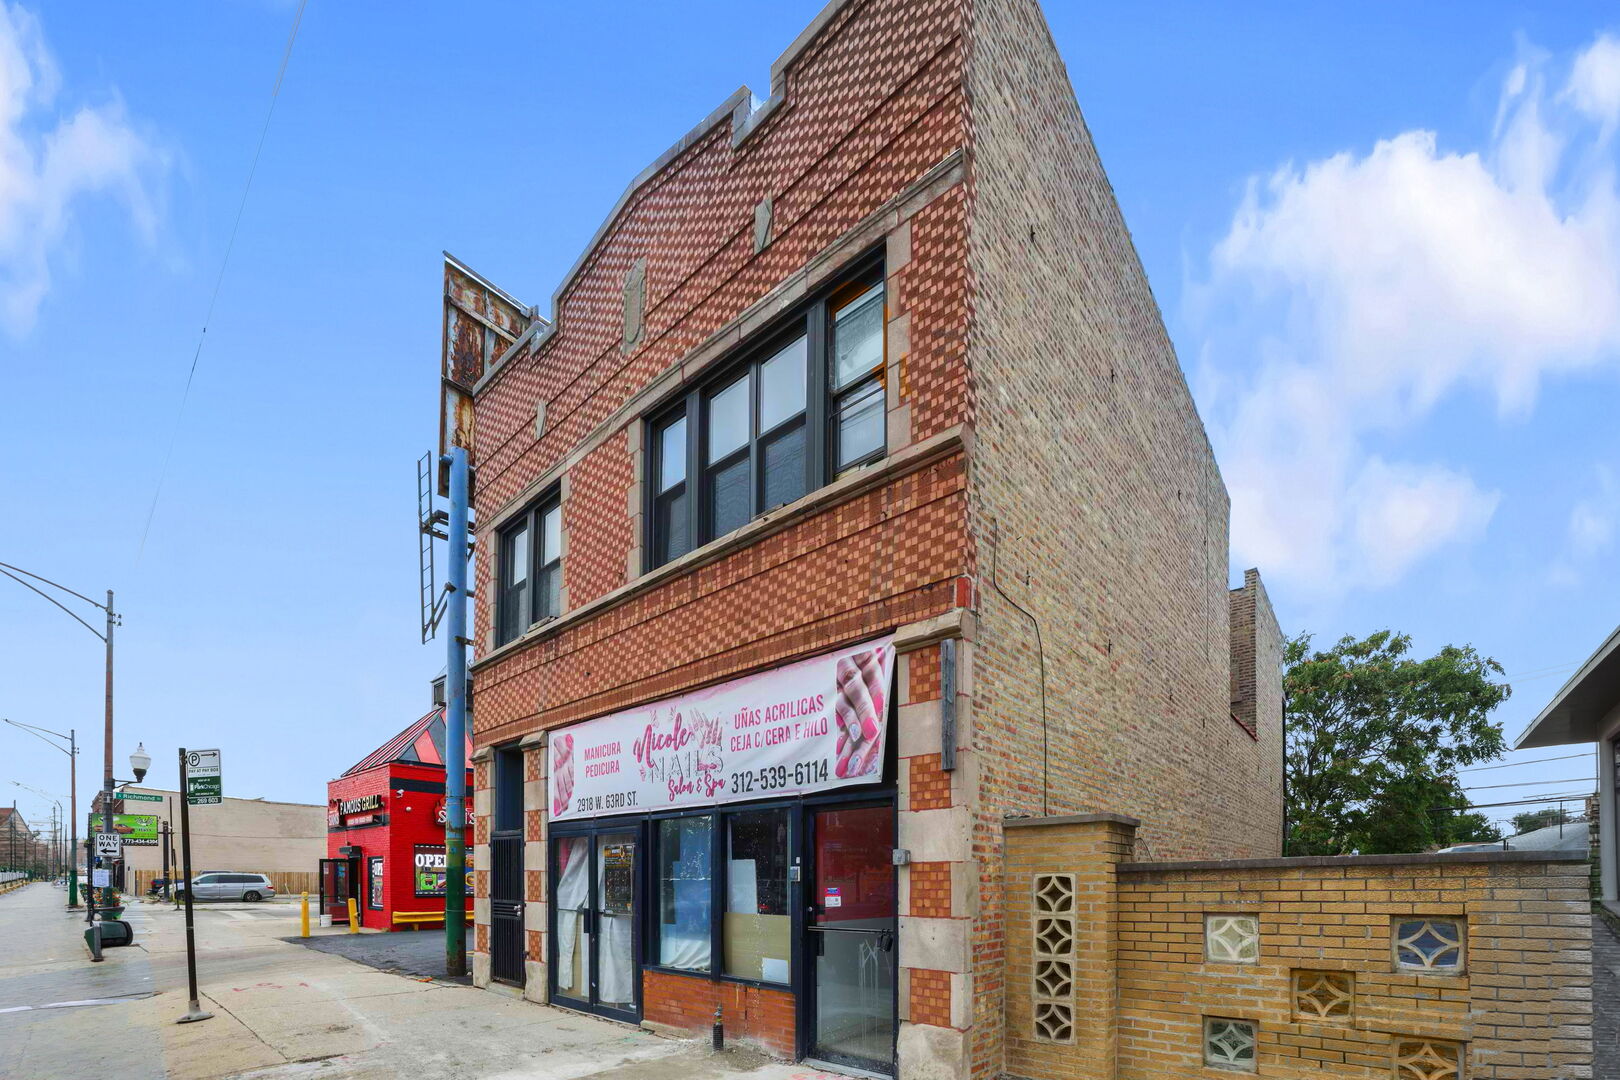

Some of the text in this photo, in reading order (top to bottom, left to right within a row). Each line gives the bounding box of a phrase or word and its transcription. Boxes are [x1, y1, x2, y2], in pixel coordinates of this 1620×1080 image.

[734, 694, 824, 729] UÑAS ACRILICAS
[633, 712, 692, 768] Nicole
[730, 733, 752, 752] CEJA
[804, 717, 828, 738] HILO
[584, 741, 621, 760] MANICURA
[585, 760, 620, 778] PEDICURA
[731, 759, 828, 794] 312-539-6114
[122, 793, 156, 801] Richmond
[668, 775, 694, 801] Salon
[704, 773, 726, 797] Spa
[340, 795, 379, 815] FAMOUS GRILL
[577, 791, 638, 812] 2918 W. 63RD ST.
